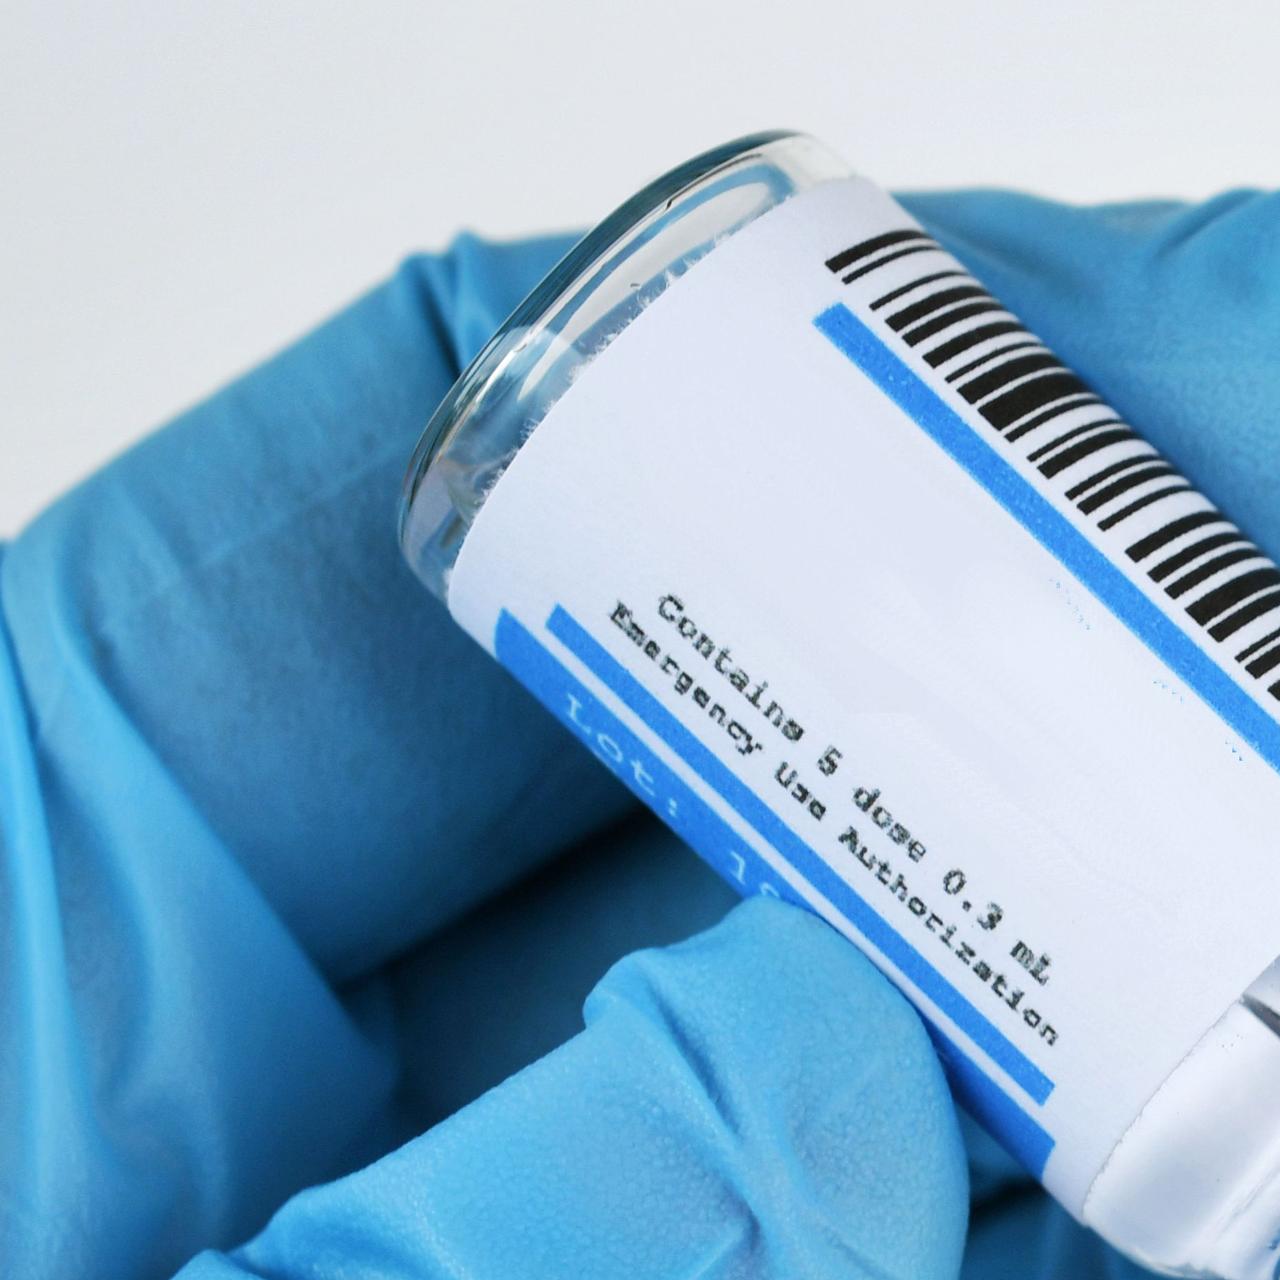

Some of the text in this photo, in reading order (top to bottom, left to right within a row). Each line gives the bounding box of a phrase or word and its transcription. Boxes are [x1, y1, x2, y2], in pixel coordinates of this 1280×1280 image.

[566, 692, 678, 818] Lot:
[609, 600, 1057, 1047] Emergency Use Authorization
[657, 594, 1053, 988] Contains 5 dose 0.3 mL
